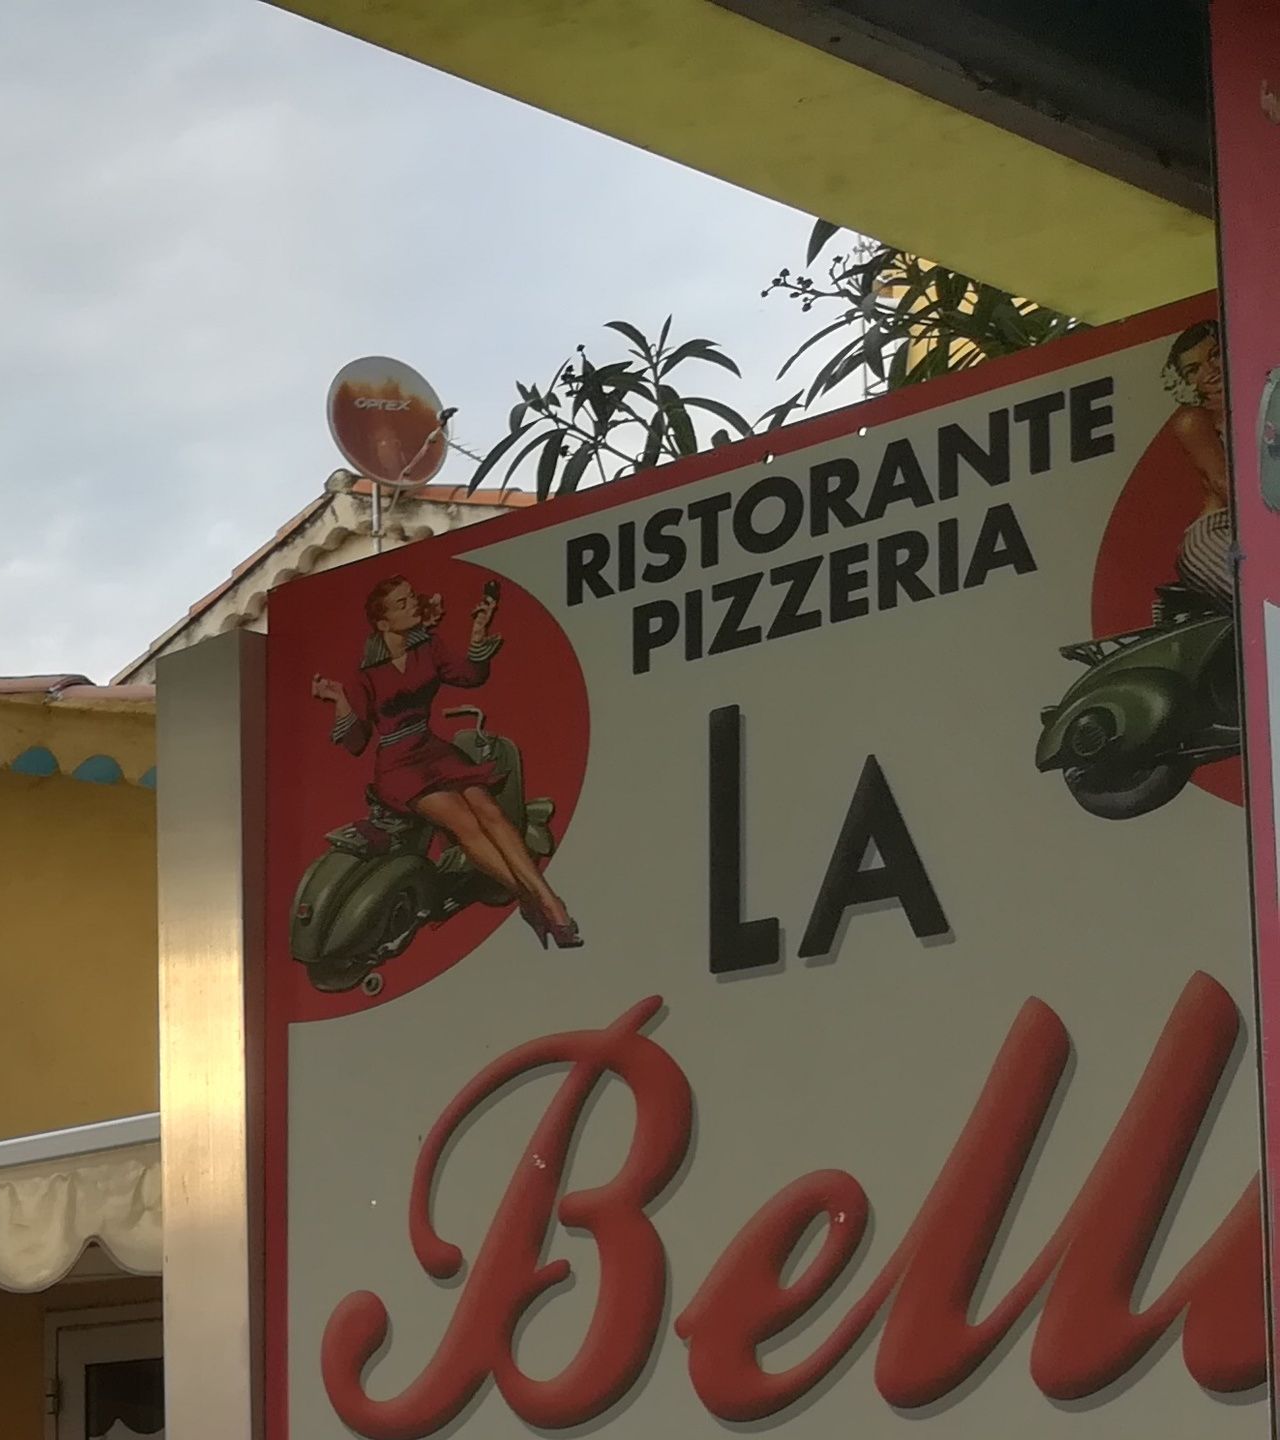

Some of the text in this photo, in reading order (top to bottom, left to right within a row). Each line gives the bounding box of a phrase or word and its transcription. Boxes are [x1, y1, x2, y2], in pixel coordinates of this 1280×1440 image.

[354, 397, 412, 411] OPTEX
[564, 376, 1115, 608] RISTORANTE
[631, 504, 1037, 675] PIZZERIA
[707, 703, 952, 975] LA
